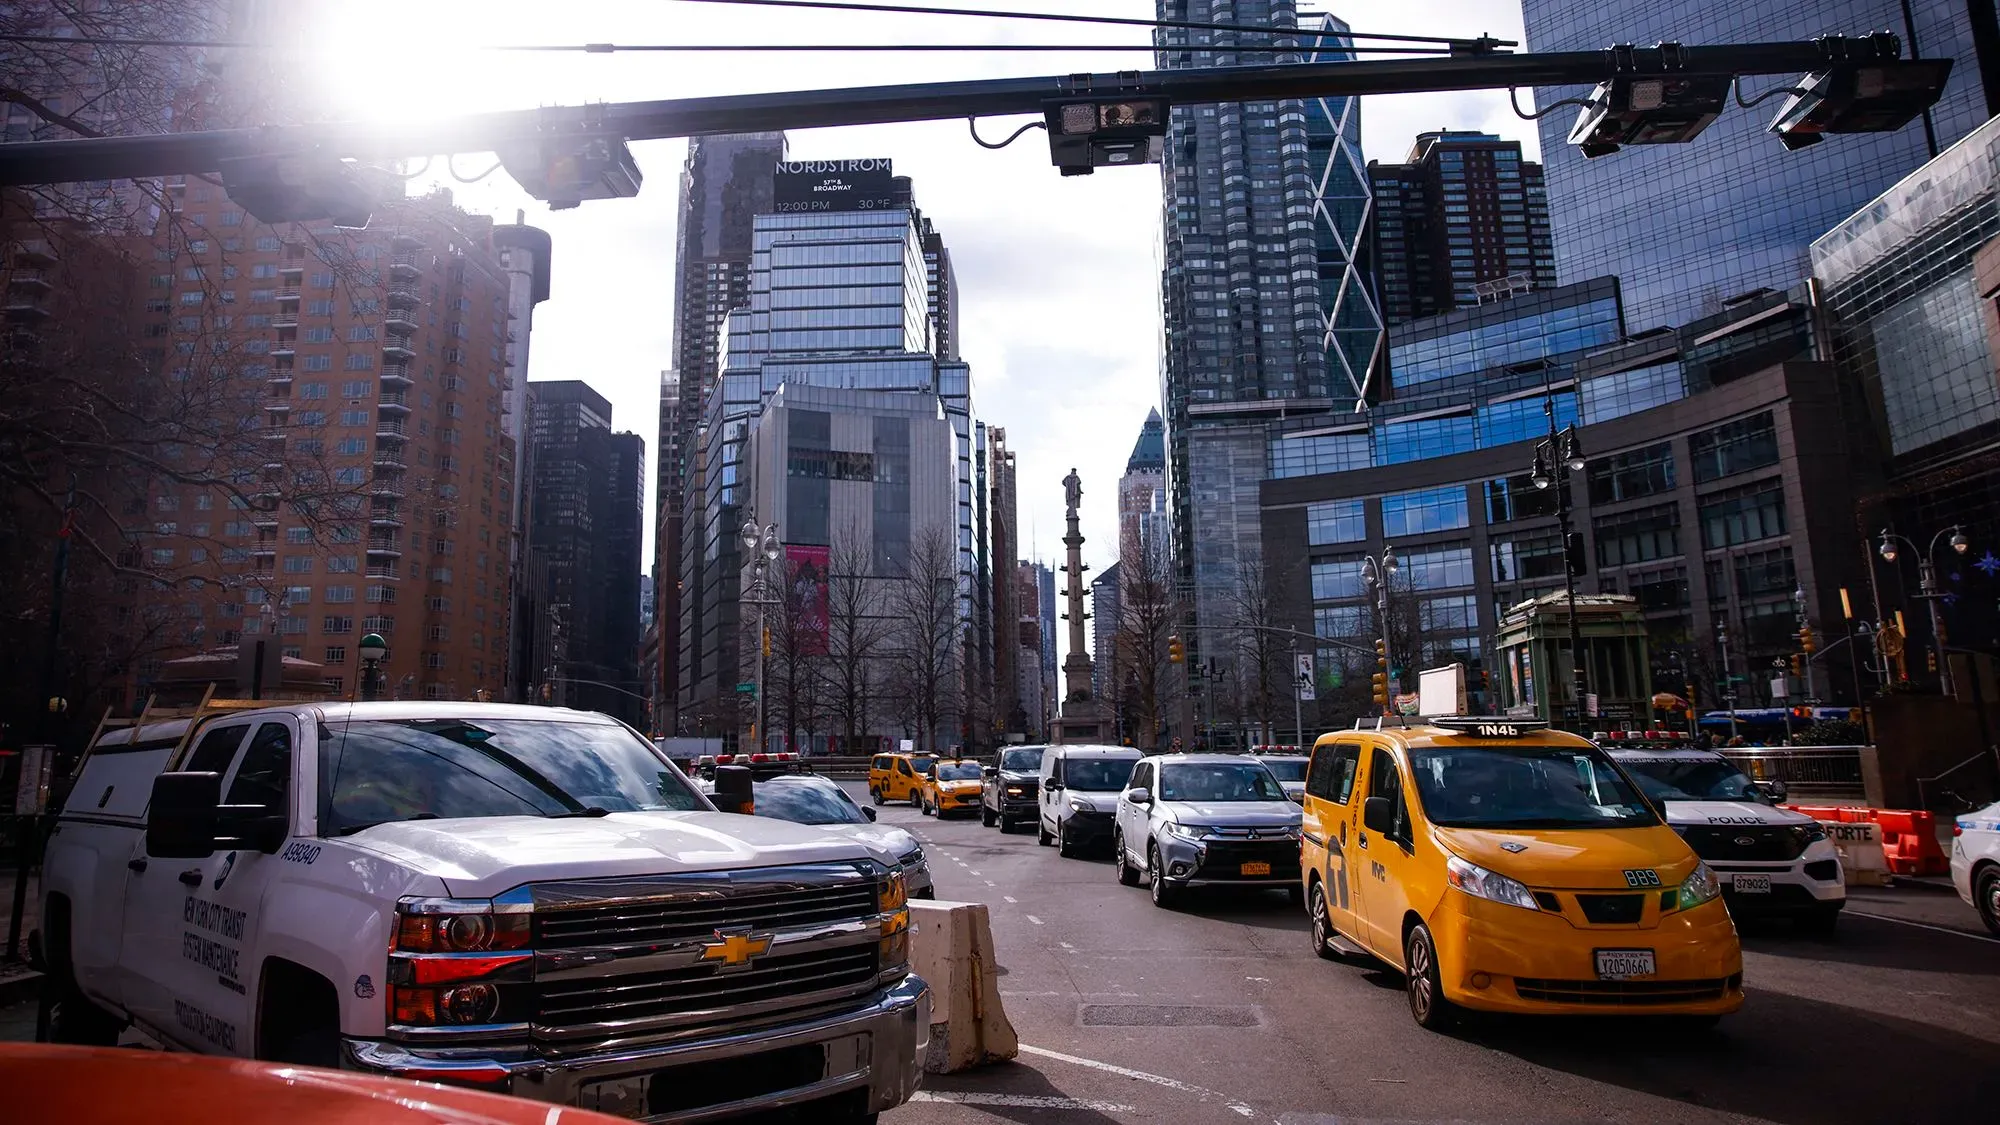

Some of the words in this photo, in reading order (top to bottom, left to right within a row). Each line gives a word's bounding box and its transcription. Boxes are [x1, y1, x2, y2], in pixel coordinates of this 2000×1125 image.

[775, 158, 890, 174] NORDSTROM
[813, 184, 852, 192] BROADWAY
[777, 201, 808, 212] 12:00
[811, 201, 830, 210] PM
[858, 199, 874, 209] 30
[1707, 816, 1768, 825] POLICE
[280, 842, 322, 865] A9934D
[1371, 859, 1385, 883] NYC
[1736, 878, 1769, 889] 379023
[184, 895, 194, 924] NEW
[194, 898, 210, 929] YORK
[207, 903, 223, 933] CITY
[220, 906, 247, 942] TRANSIT
[183, 931, 202, 964] SYSTEM
[201, 937, 239, 979] MAINTENANCE
